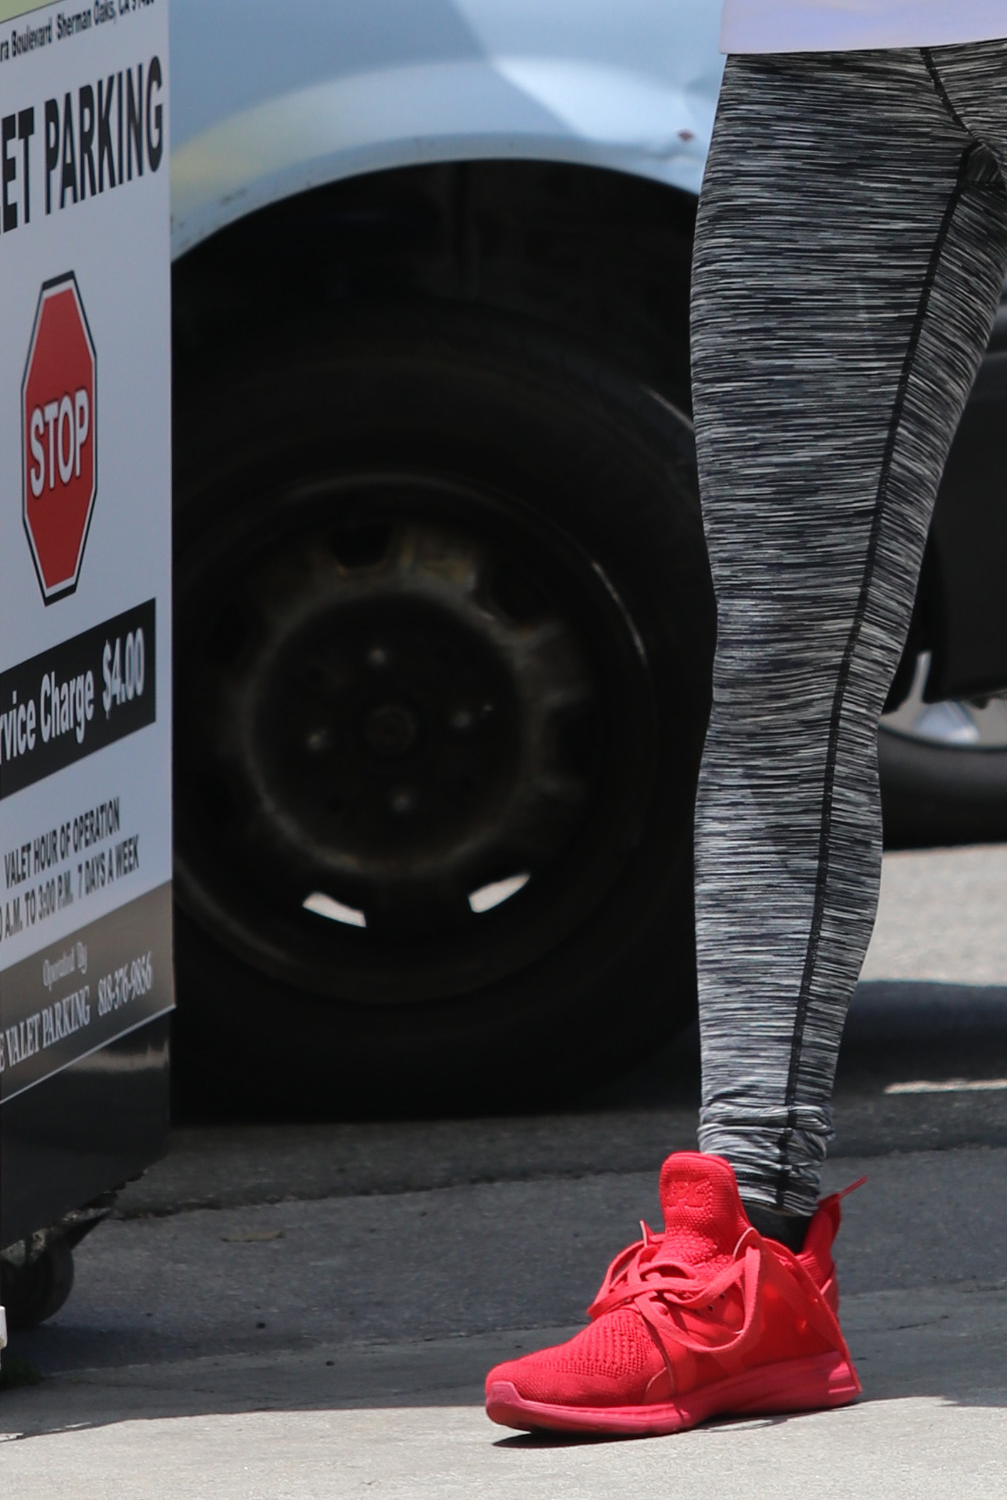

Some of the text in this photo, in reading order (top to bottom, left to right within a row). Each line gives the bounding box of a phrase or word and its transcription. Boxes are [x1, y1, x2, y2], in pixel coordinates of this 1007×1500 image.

[11, 16, 53, 58] Boulevard
[56, 8, 92, 41] Sherman
[44, 55, 163, 216] PARKING
[29, 387, 90, 499] STOP
[40, 669, 95, 744] Charge
[102, 626, 145, 720] $4.00
[4, 796, 120, 890] VALET HOUR OF OPERATION
[24, 888, 36, 927] TO
[77, 863, 83, 899] 7
[85, 852, 106, 896] DAYS
[107, 847, 114, 884] A
[114, 833, 140, 879] WEEK
[5, 1012, 41, 1067] VALET
[41, 985, 91, 1049] PARKING
